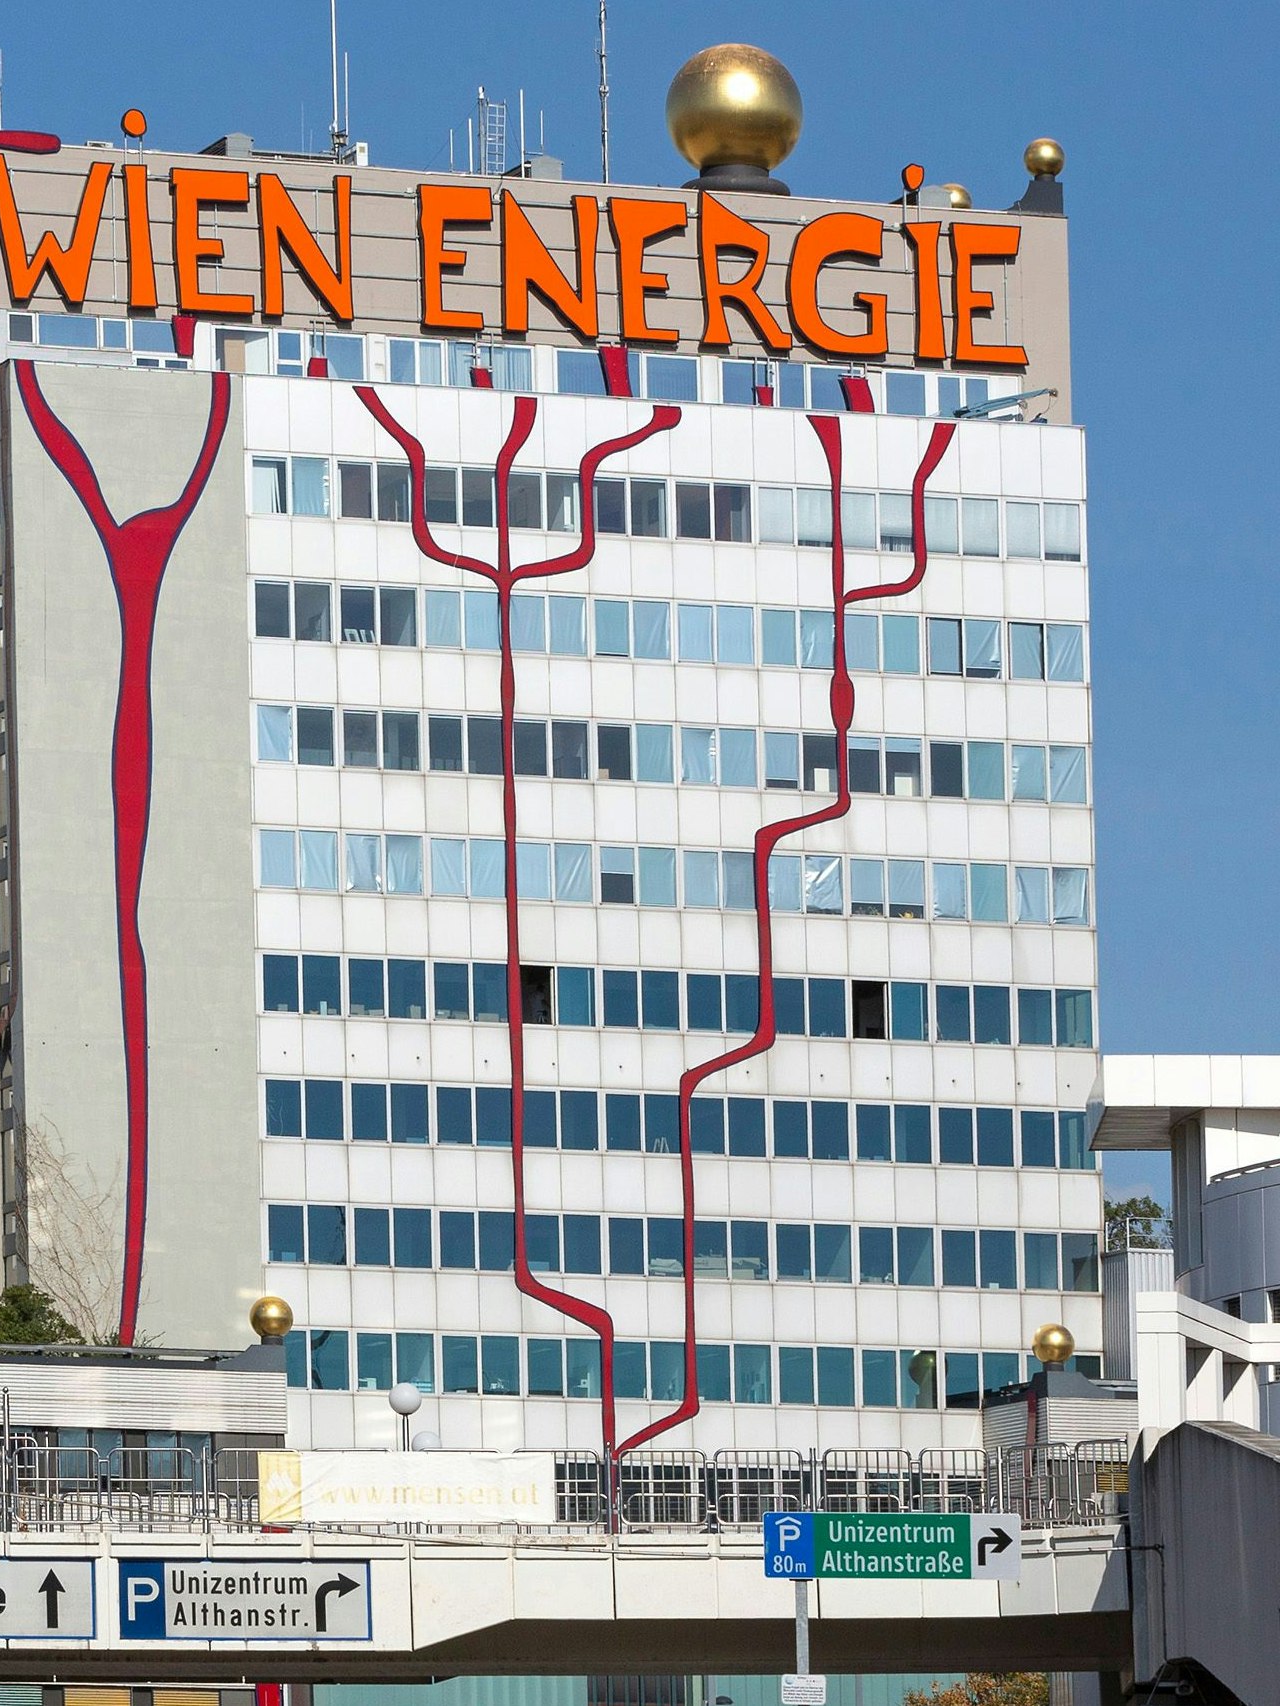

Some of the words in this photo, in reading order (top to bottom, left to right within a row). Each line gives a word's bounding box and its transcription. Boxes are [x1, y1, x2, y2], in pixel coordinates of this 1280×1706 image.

[418, 163, 1029, 366] ENERGIE
[779, 1525, 801, 1551] P
[828, 1519, 955, 1543] Unizentrum
[822, 1550, 964, 1573] Althanstraße
[171, 1570, 308, 1595] Unizentrum
[127, 1577, 160, 1621] P
[173, 1602, 309, 1627] Althanstr.
